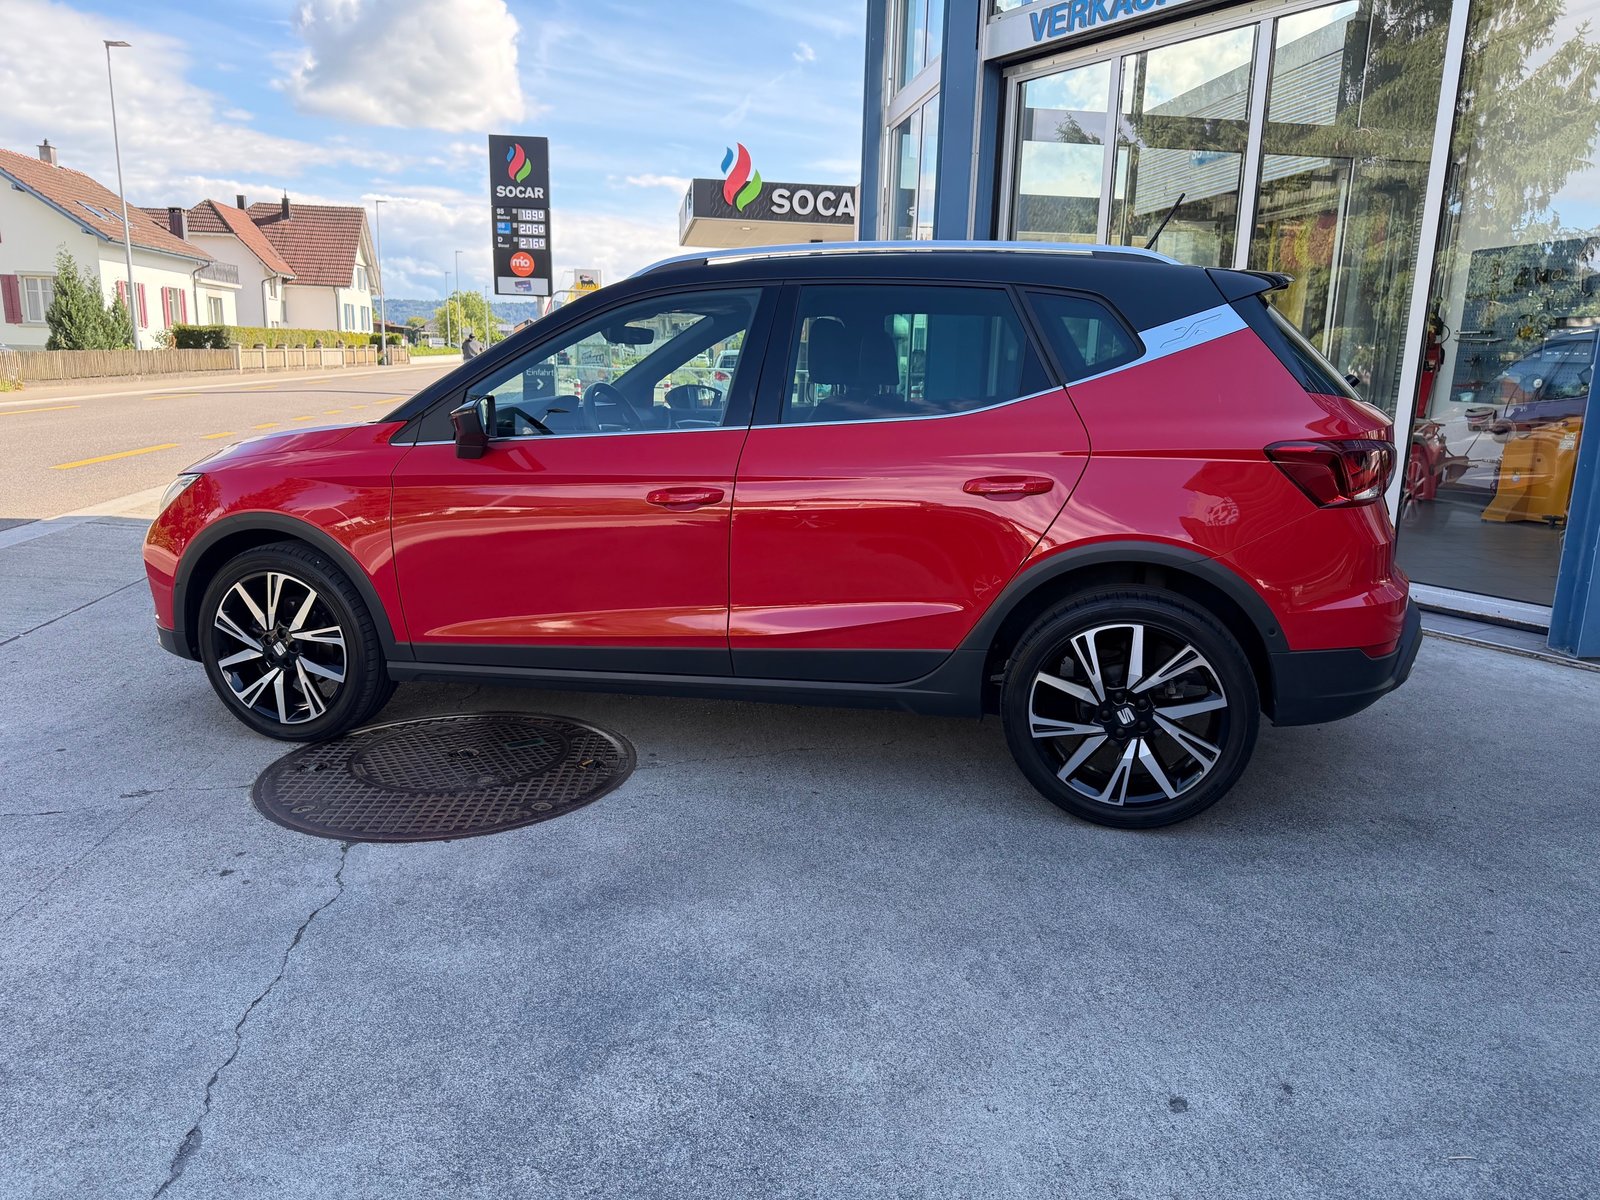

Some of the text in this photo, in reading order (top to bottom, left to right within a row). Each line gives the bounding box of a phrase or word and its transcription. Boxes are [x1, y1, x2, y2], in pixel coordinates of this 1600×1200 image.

[1029, 0, 1167, 42] VERKA
[496, 185, 544, 199] SOCAR
[771, 188, 855, 217] SOCA
[513, 256, 530, 267] mio
[526, 368, 554, 376] Einfahrt
